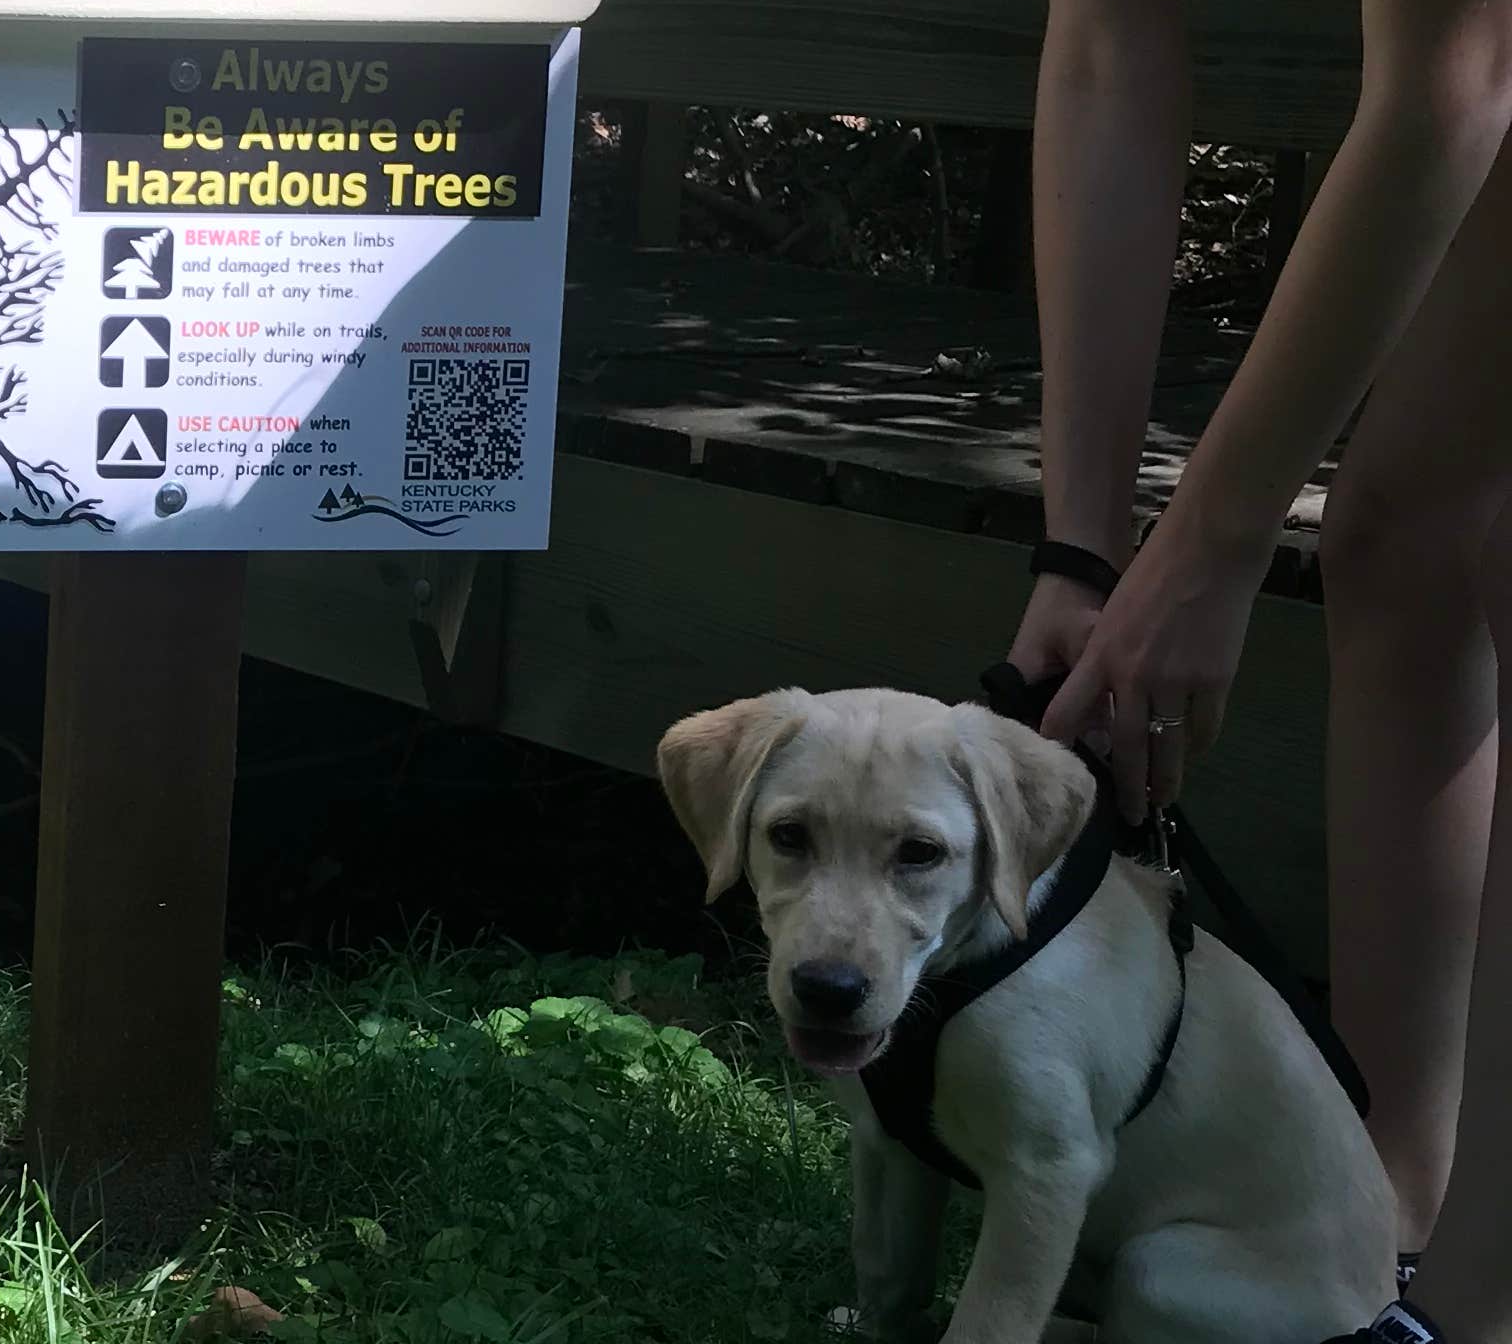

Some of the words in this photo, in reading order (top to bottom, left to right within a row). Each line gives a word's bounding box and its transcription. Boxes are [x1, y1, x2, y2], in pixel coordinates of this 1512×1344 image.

[212, 48, 389, 103] Always
[163, 106, 223, 150] Be
[239, 107, 396, 152] Aware
[414, 108, 465, 152] of
[105, 160, 367, 206] Hazardous
[384, 164, 517, 207] Trees
[185, 230, 261, 246] BEWARE
[264, 230, 282, 247] of
[290, 231, 346, 247] broken
[354, 232, 395, 247] limbs
[182, 257, 210, 272] and
[218, 257, 289, 277] damaged
[298, 259, 341, 273] trees
[349, 260, 384, 274] that
[182, 285, 214, 302] may
[223, 282, 249, 297] fall
[257, 285, 275, 297] at
[282, 286, 310, 301] any
[318, 284, 359, 299] time.
[181, 321, 231, 337] LOOK
[236, 321, 260, 337] UP
[265, 322, 305, 337] while
[313, 327, 331, 337] on
[340, 324, 388, 341] trails,
[421, 326, 446, 337] SCAN
[449, 326, 463, 338] QR
[465, 326, 490, 337] CODE
[492, 326, 511, 337] FOR
[401, 343, 461, 353] ADDITIONAL
[463, 343, 530, 353] INFORMATION
[177, 349, 256, 367] especially
[263, 350, 313, 367] during
[321, 350, 367, 368] windy
[176, 372, 263, 387] conditions.
[178, 416, 211, 432] USE
[218, 416, 300, 432] CAUTION
[310, 415, 350, 431] when
[176, 439, 246, 457] selecting
[255, 443, 263, 453] a
[272, 439, 313, 455] place
[320, 439, 337, 453] to
[174, 463, 224, 480] camp,
[235, 461, 285, 480] picnic
[293, 464, 312, 476] or
[319, 461, 363, 477] rest.
[401, 485, 496, 496] KENTUCKY
[401, 500, 455, 513] STATE
[459, 500, 516, 513] PARKS
